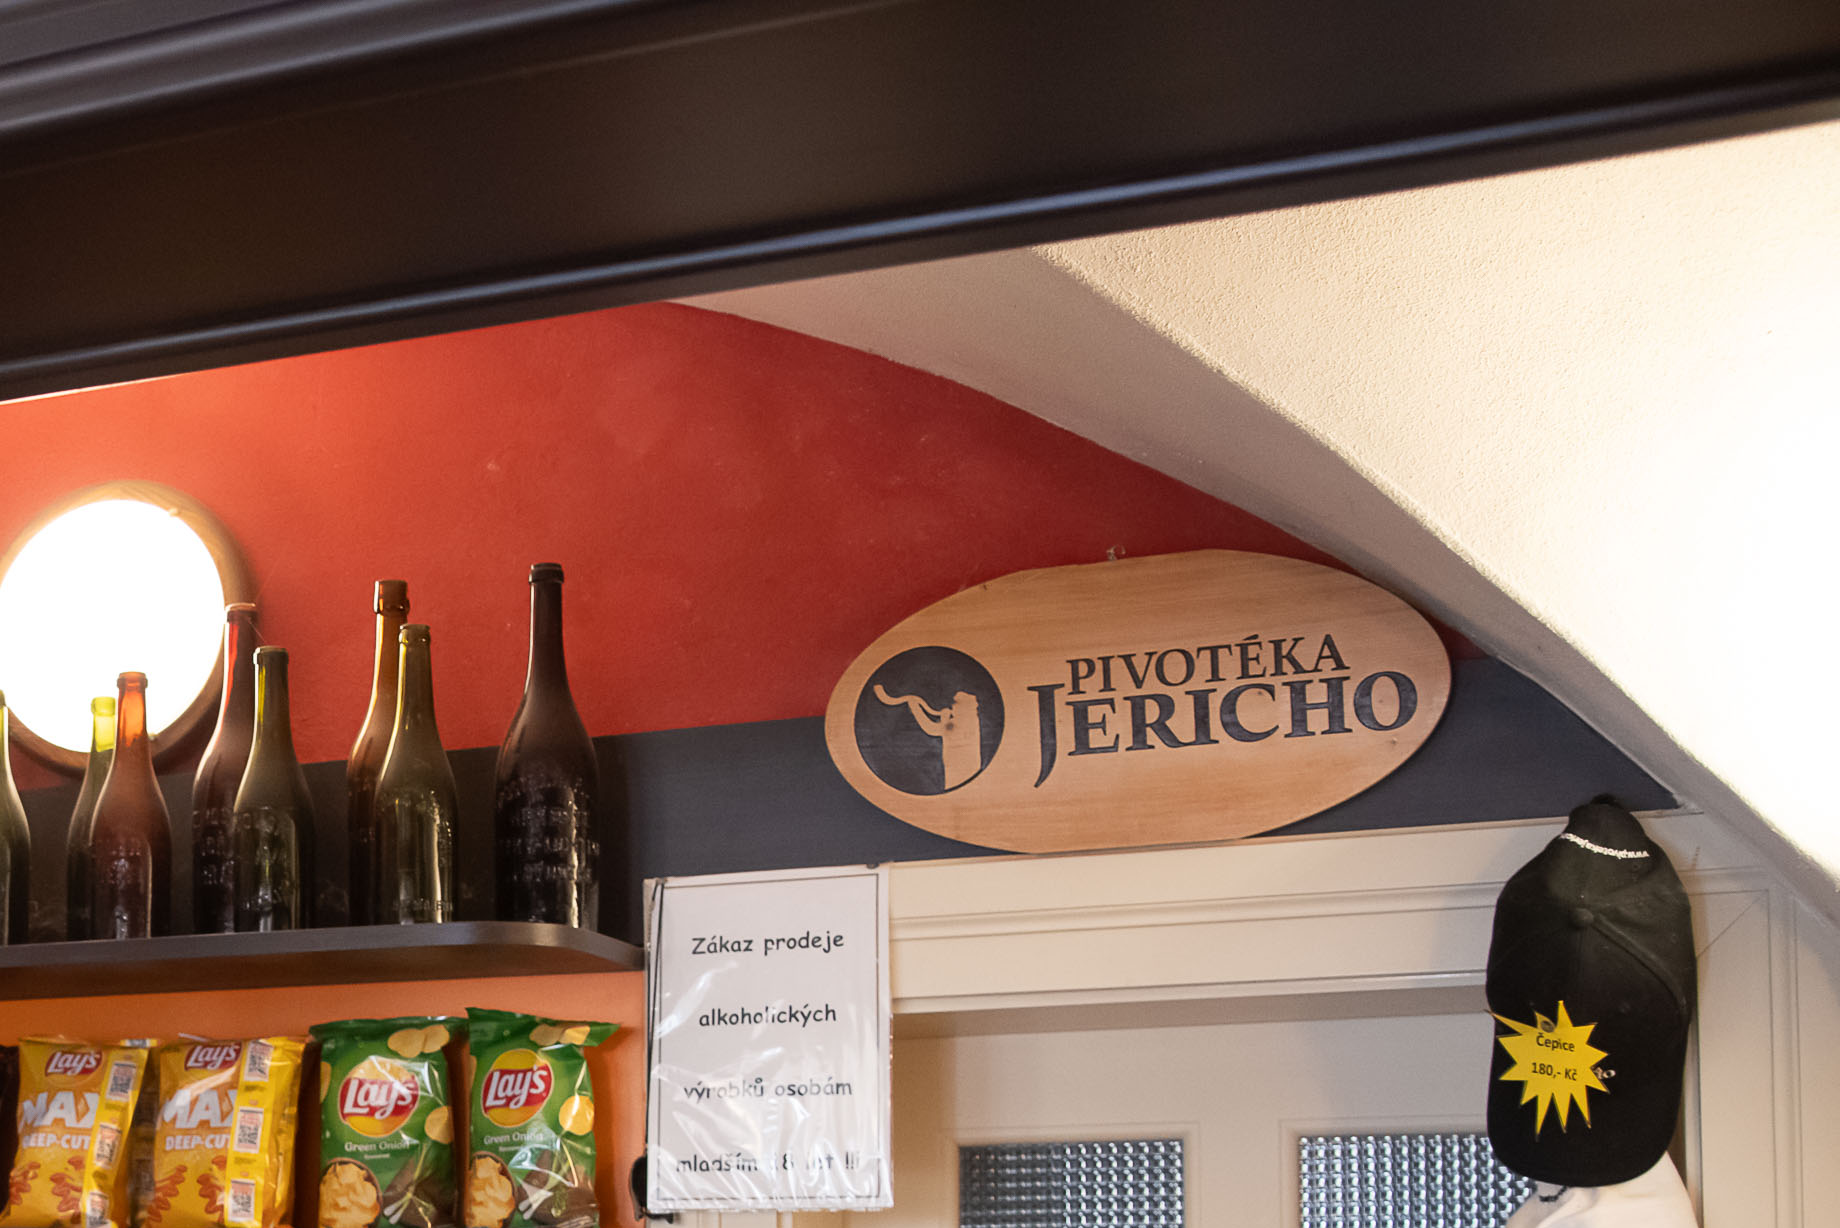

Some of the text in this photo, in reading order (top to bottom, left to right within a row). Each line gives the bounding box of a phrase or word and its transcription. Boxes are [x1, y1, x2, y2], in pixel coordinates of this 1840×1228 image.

[1067, 634, 1350, 695] PIVOTÉKA
[1027, 671, 1418, 788] JERICHO
[692, 931, 844, 956] Zákaz prodeje
[699, 1003, 837, 1028] alkoholických
[1536, 1032, 1575, 1052] Čepice
[47, 1051, 101, 1076] Lay's
[187, 1045, 240, 1070] Lay's
[343, 1075, 418, 1120] Lay's
[485, 1064, 547, 1109] Lay's
[684, 1077, 852, 1103] výrobků osobám
[344, 1140, 410, 1152] Green Onion
[484, 1134, 510, 1145] Green
